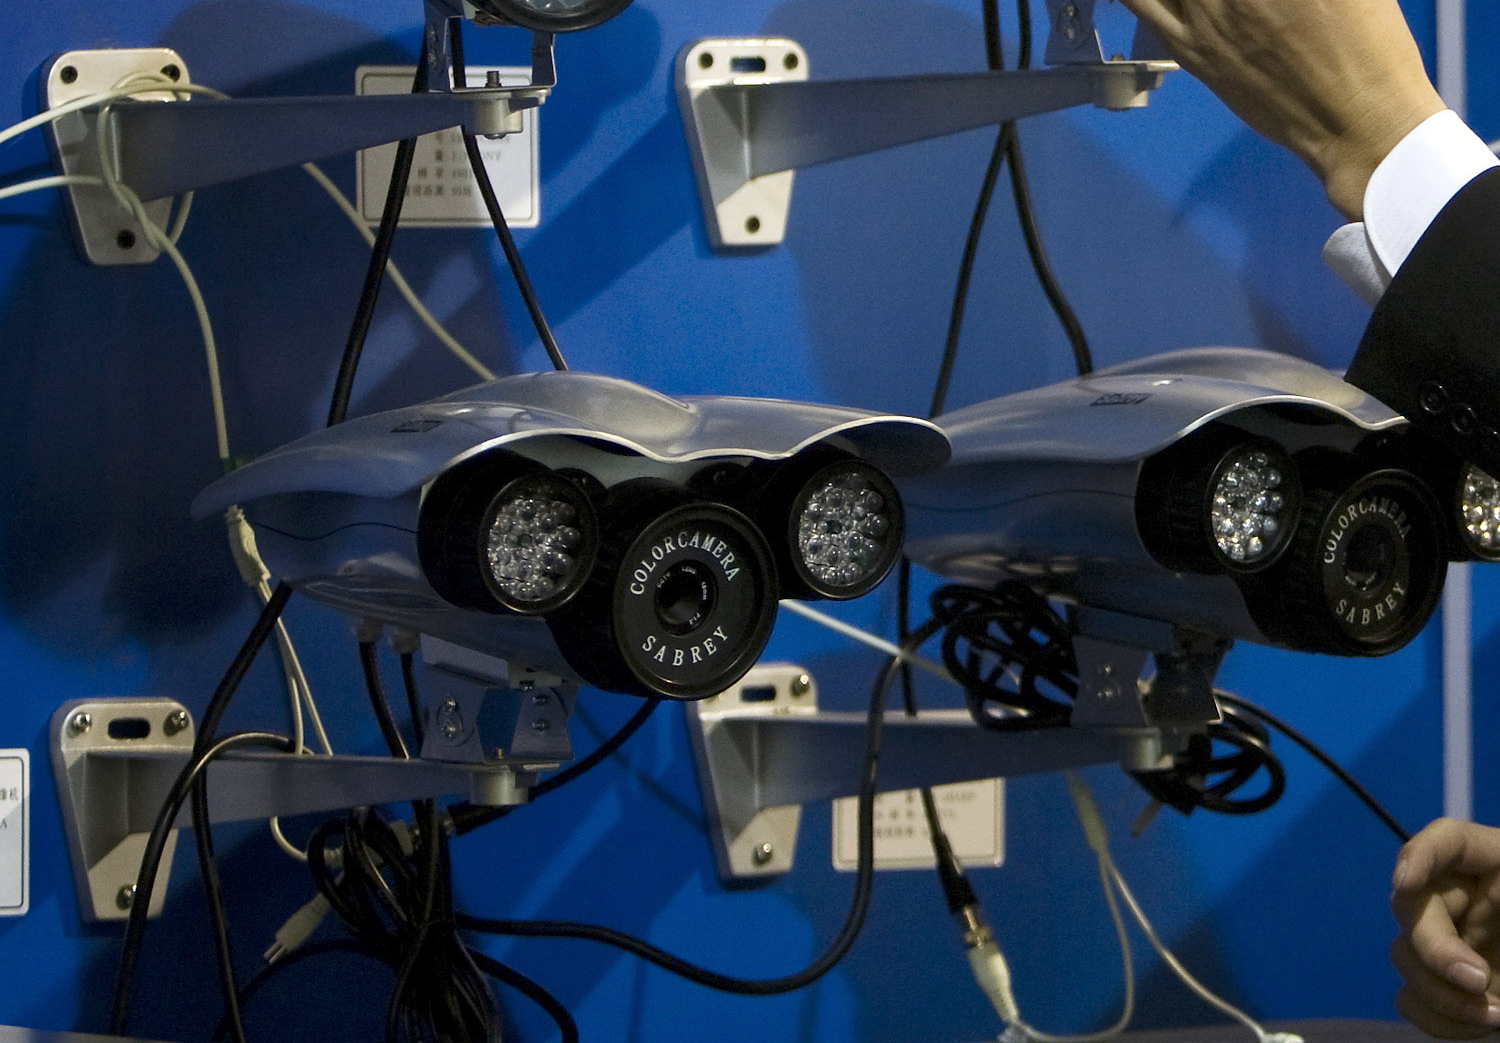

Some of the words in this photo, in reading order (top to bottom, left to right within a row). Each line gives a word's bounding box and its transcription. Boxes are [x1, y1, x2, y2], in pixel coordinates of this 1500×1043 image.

[630, 531, 740, 595] COLORCAMERA
[1336, 582, 1405, 625] SABREY
[642, 626, 728, 666] SABREY
